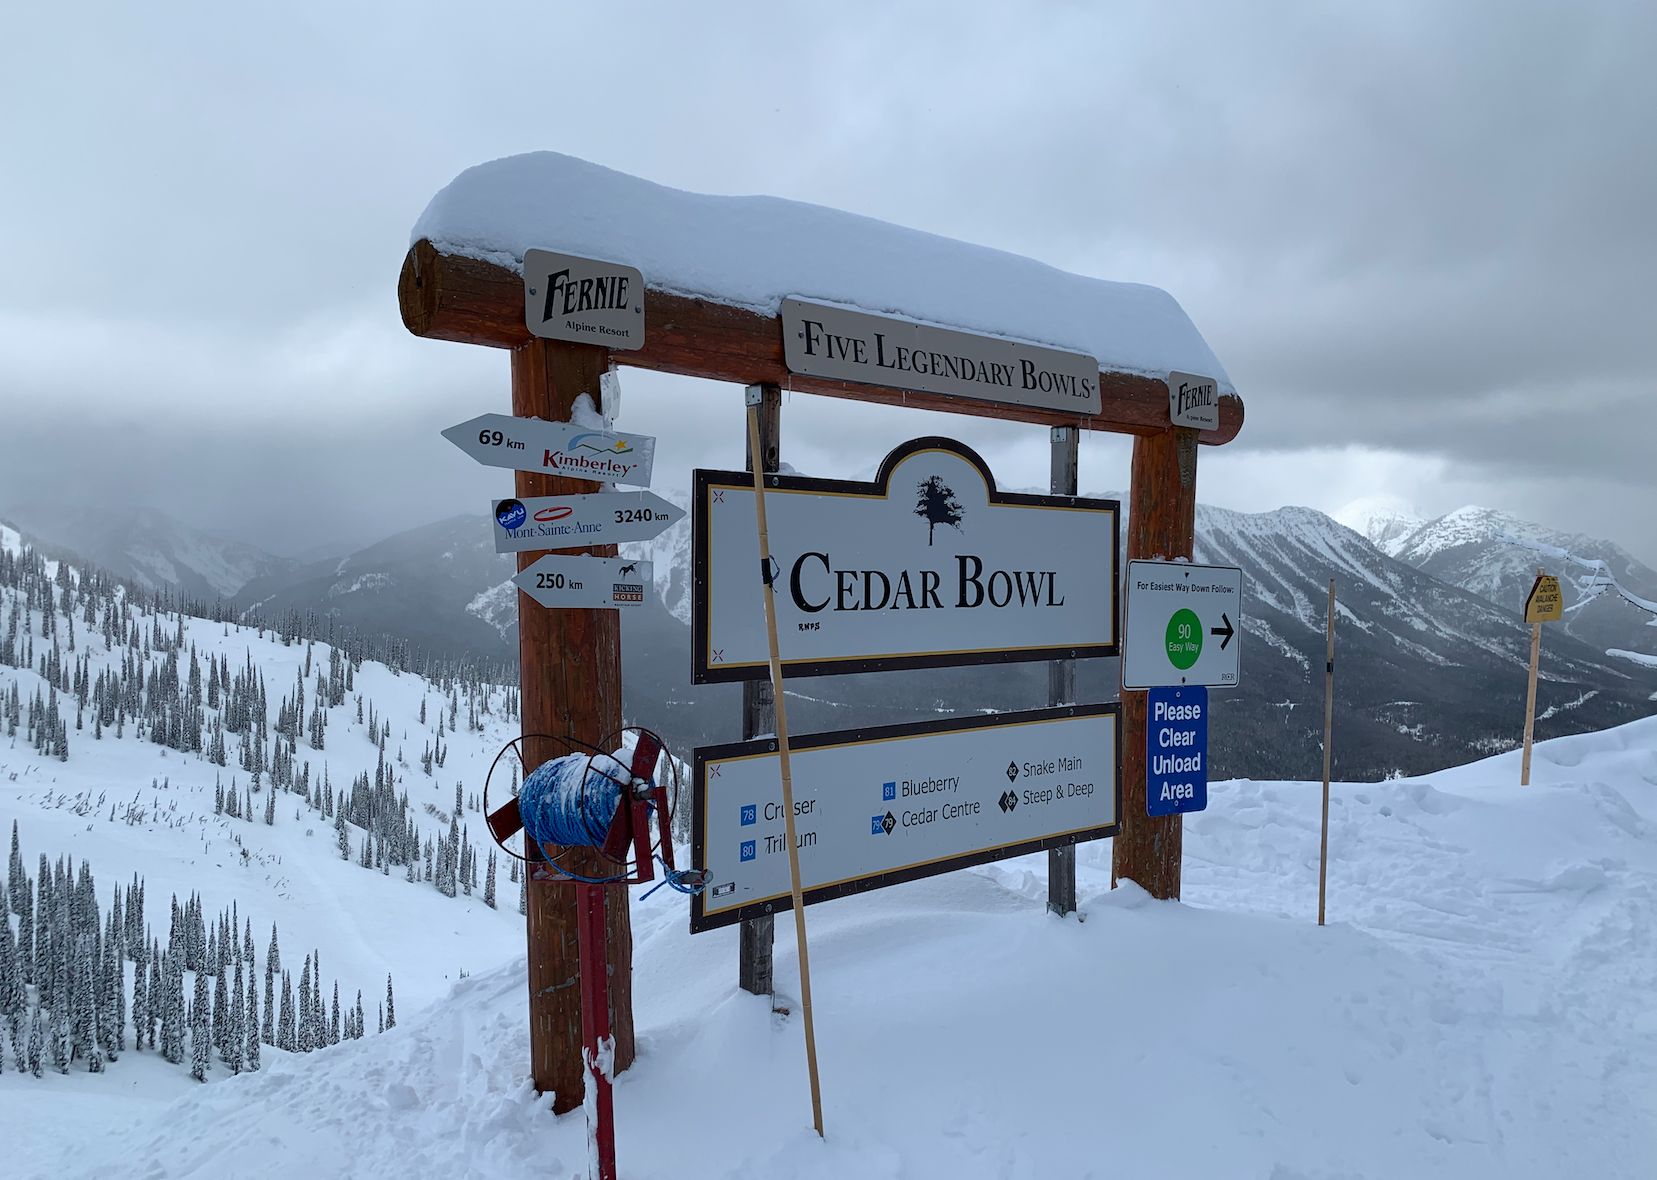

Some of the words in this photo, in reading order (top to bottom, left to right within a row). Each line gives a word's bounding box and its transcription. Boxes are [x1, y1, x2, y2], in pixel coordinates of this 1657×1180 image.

[542, 268, 629, 323] FERNIE
[565, 320, 596, 332] Alpine
[599, 325, 630, 337] Resort
[801, 319, 868, 365] FIVE
[873, 332, 1015, 387] LEGENDARY
[1019, 358, 1091, 399] BOWLS
[1177, 382, 1212, 416] FERNIE
[479, 429, 504, 446] 69
[506, 438, 525, 450] km
[543, 449, 631, 478] Kimberley
[499, 507, 525, 524] KAVU
[614, 508, 652, 523] 3240
[654, 512, 669, 521] km
[536, 573, 565, 589] 250
[569, 579, 583, 590] km
[789, 551, 945, 613] CEDAR
[954, 555, 1065, 608] BOWL
[1137, 581, 1149, 590] For
[1150, 582, 1174, 591] Easiest
[1176, 583, 1190, 593] Way
[1191, 584, 1210, 592] Down
[1211, 585, 1235, 593] Follow:
[1535, 594, 1558, 603] AVALANCHE
[1537, 604, 1554, 613] DANGER
[1178, 624, 1191, 639] 90
[1168, 642, 1184, 653] Easy
[1185, 642, 1199, 653] Way
[1154, 701, 1201, 721] Please
[1159, 727, 1196, 748] Clear
[1008, 766, 1017, 777] 82
[1023, 760, 1055, 777] Snake
[1058, 756, 1082, 772] Main
[1153, 751, 1201, 775] Unload
[884, 786, 894, 797] 81
[902, 777, 960, 797] Blueberry
[1023, 789, 1052, 805] Steep
[1056, 784, 1065, 799] &
[1067, 783, 1094, 798] Deep
[1160, 781, 1194, 801] Area
[743, 809, 755, 821] 78
[764, 799, 816, 821] Crser
[872, 820, 880, 831] 79
[884, 817, 894, 829] 79
[902, 807, 938, 827] Cedar
[942, 801, 980, 820] Centre
[742, 845, 754, 857] 80
[764, 832, 817, 854] Trilum
